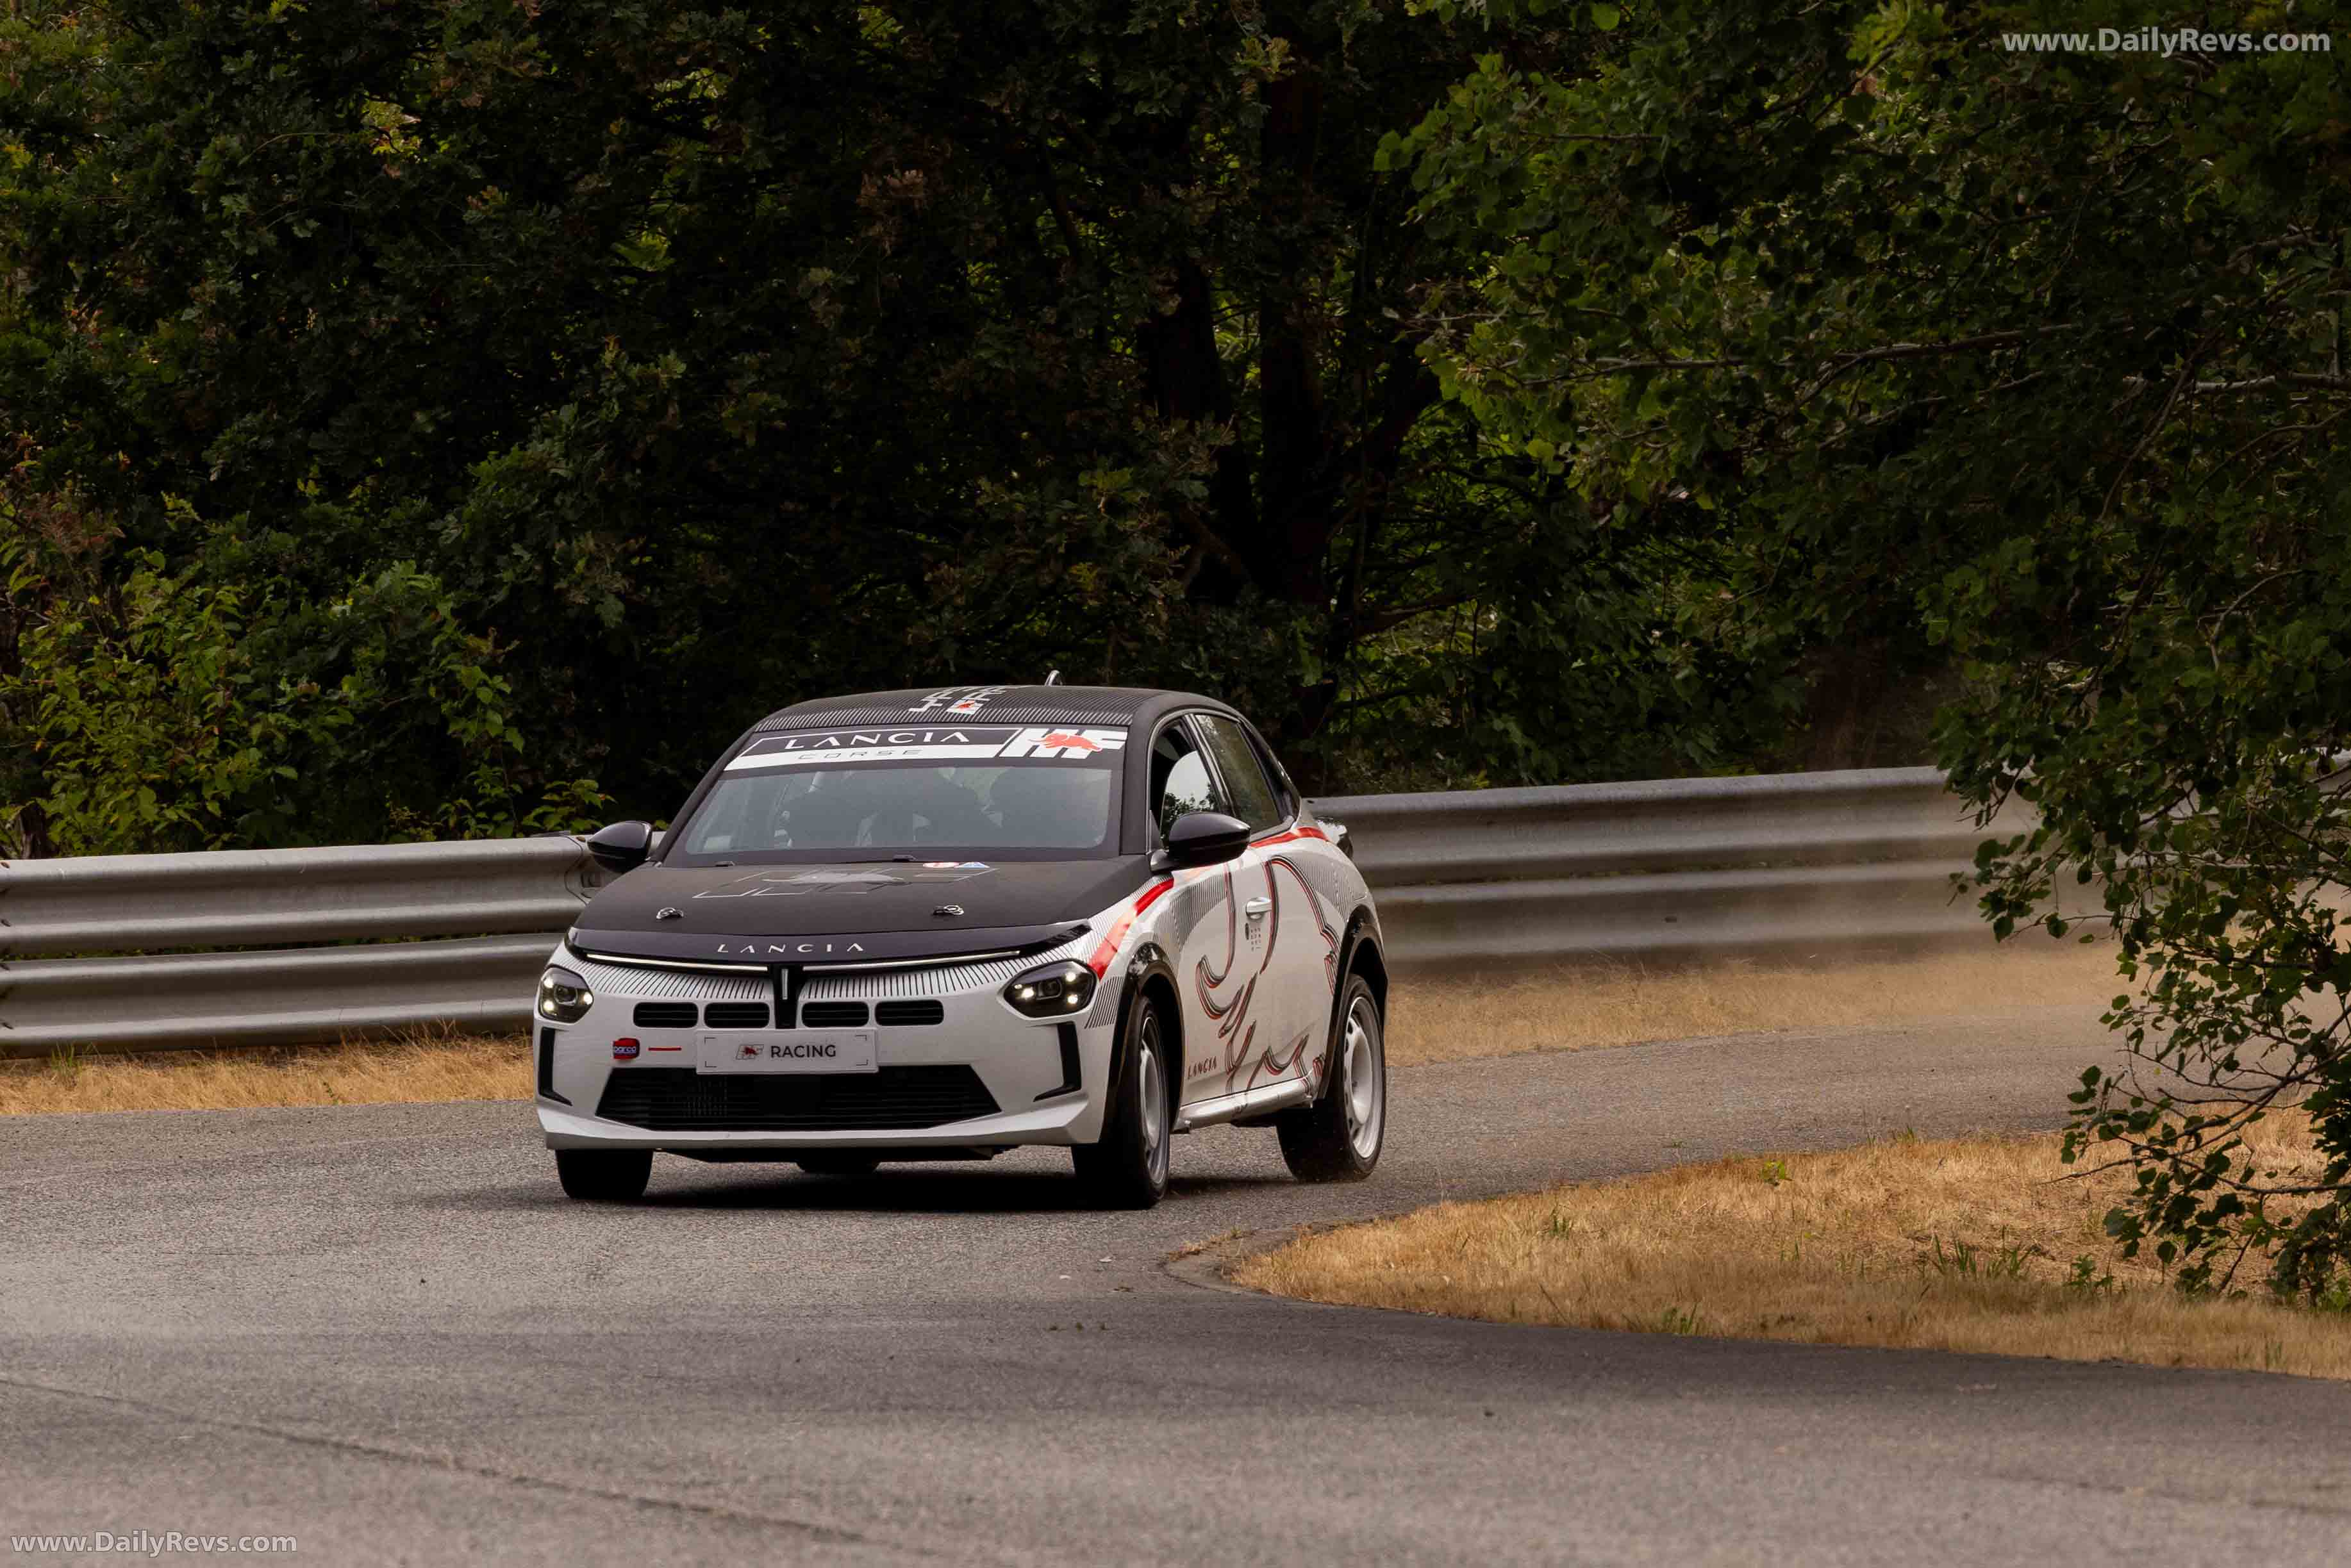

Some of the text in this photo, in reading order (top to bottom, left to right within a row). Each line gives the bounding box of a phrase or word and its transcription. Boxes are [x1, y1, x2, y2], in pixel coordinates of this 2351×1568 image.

[784, 731, 970, 750] LANCIA
[798, 748, 923, 759] CORSE
[717, 943, 864, 953] LANCIA
[770, 1044, 836, 1059] RACING
[1187, 1056, 1217, 1080] LANCIA
